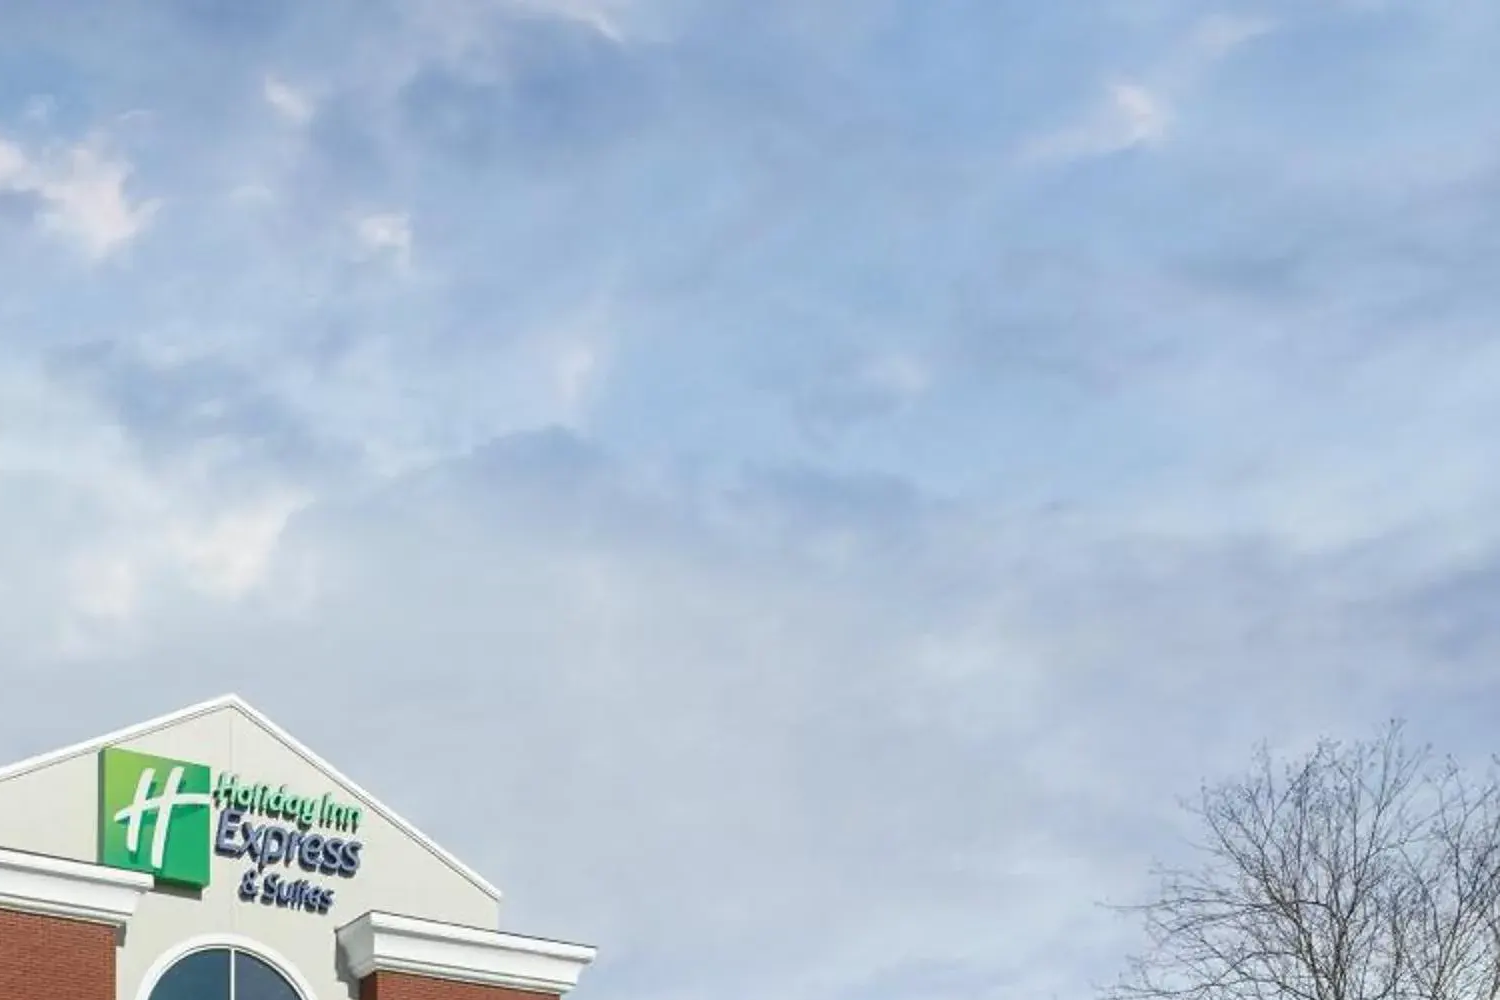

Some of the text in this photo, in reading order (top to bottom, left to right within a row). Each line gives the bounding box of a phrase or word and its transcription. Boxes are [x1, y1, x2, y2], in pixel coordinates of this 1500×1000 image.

[114, 767, 210, 869] H
[213, 772, 361, 833] Holiday Inn
[216, 809, 362, 877] Express
[239, 869, 334, 914] & Suites
